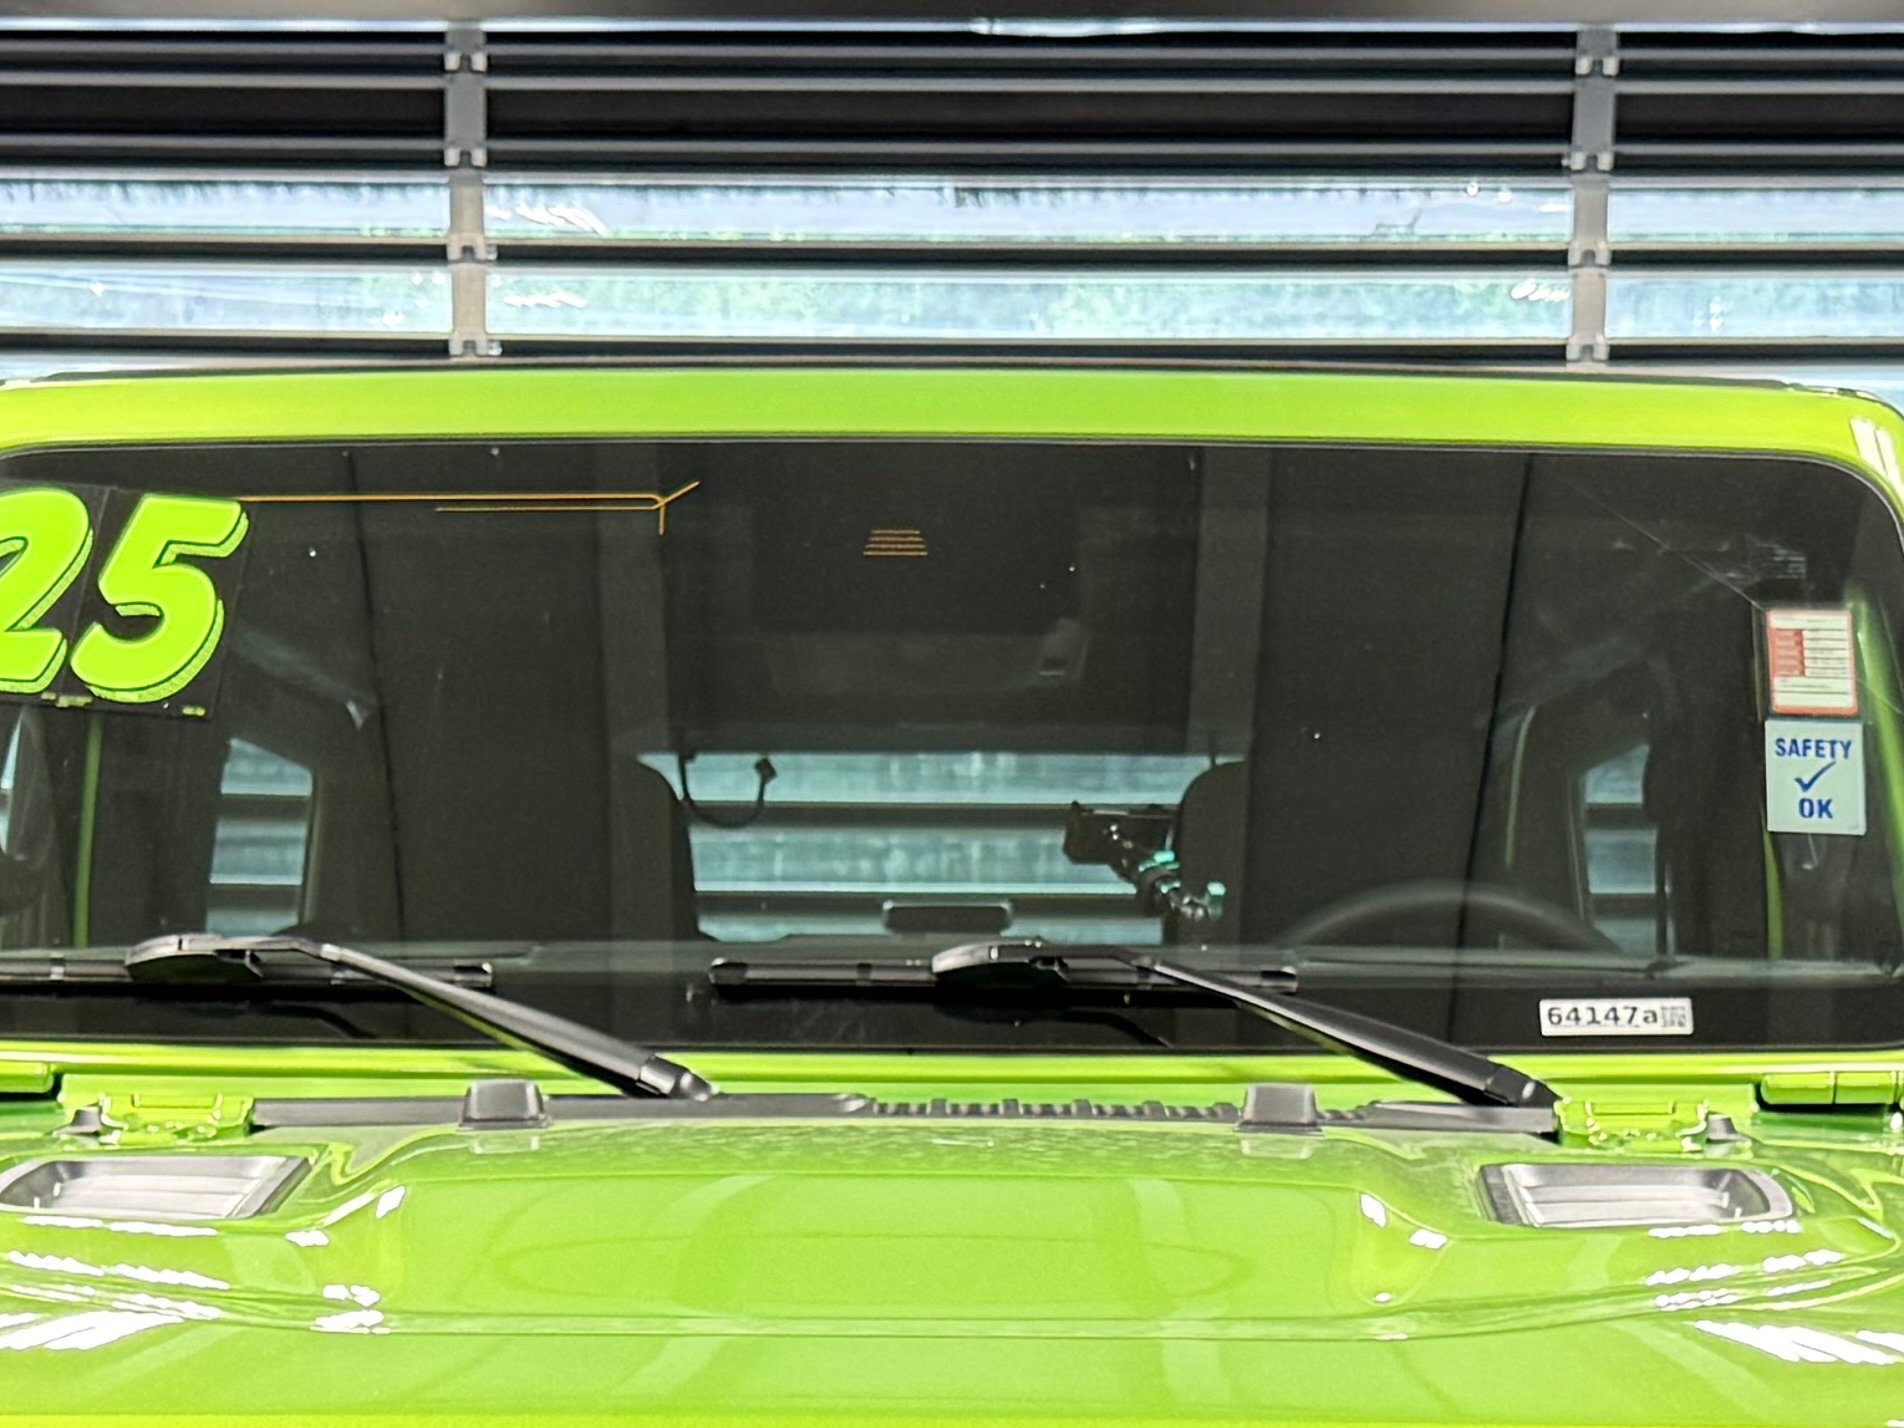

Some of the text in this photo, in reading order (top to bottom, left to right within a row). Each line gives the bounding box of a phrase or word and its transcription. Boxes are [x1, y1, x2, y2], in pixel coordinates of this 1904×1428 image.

[1774, 737, 1852, 759] SAFETY
[1798, 797, 1834, 819] OK
[1547, 1006, 1658, 1026] 64147a
